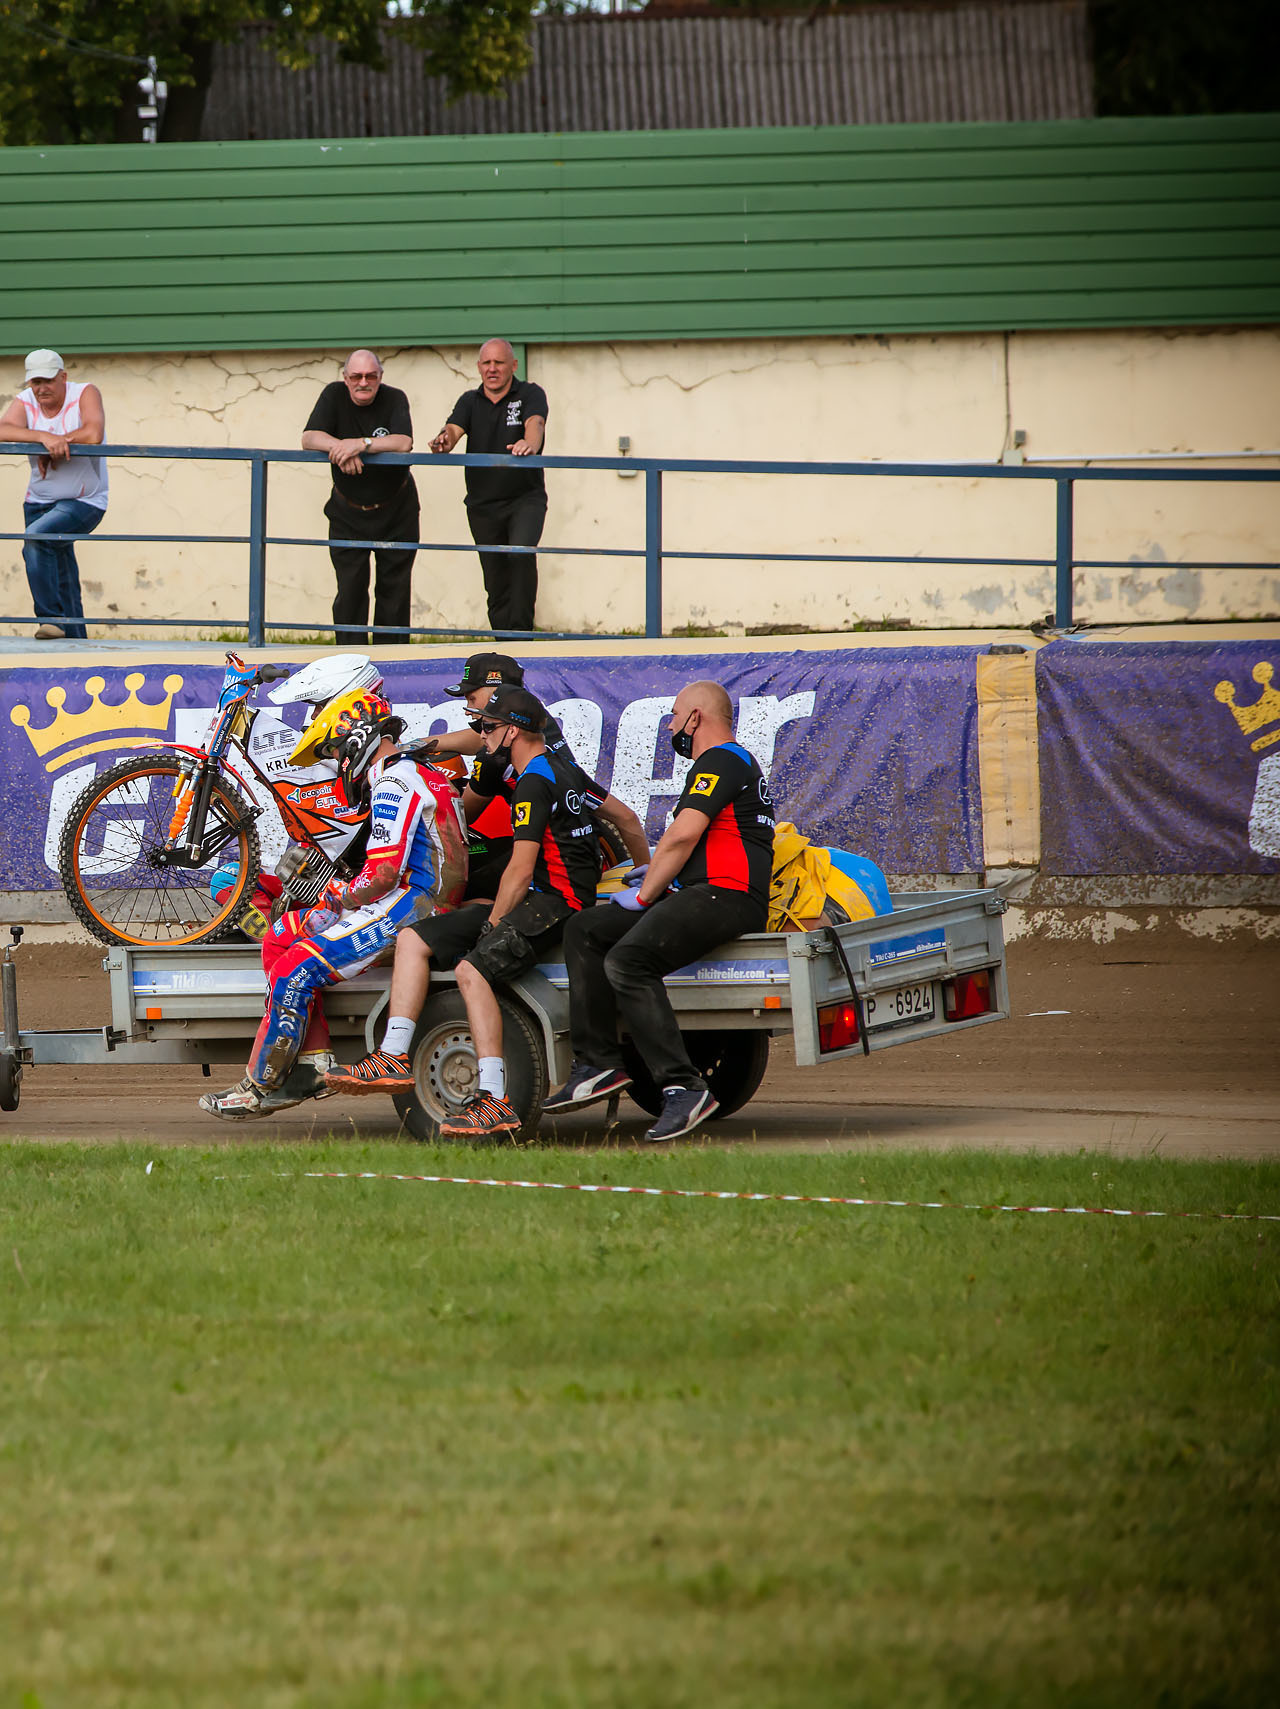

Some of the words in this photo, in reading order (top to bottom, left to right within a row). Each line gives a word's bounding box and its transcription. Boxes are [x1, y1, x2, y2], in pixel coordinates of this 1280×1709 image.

[253, 729, 295, 750] LTE
[266, 759, 294, 772] KRI
[351, 916, 397, 953] LTE
[172, 973, 196, 990] Tiki
[697, 967, 765, 980] tikitreiler.com
[283, 989, 294, 1006] DDS
[866, 1000, 876, 1024] P
